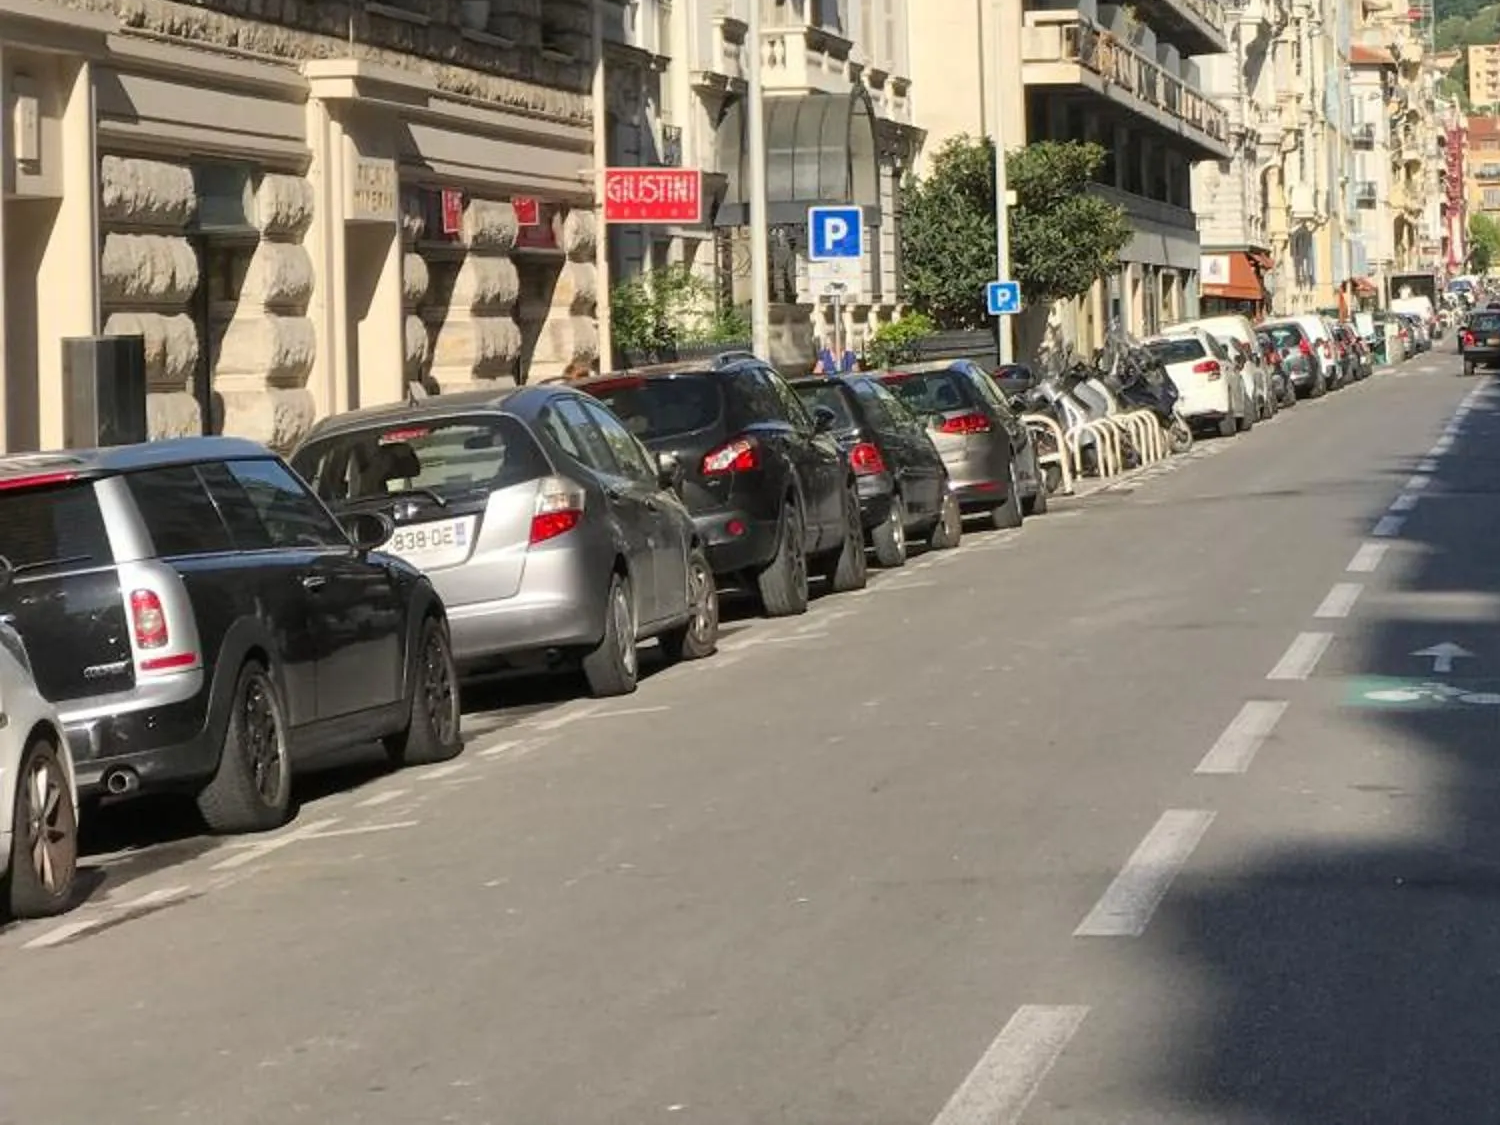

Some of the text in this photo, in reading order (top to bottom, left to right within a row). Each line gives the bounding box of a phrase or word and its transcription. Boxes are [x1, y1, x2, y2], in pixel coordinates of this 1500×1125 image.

[607, 174, 696, 204] GIUSTINI
[824, 217, 848, 251] P
[997, 287, 1011, 308] P
